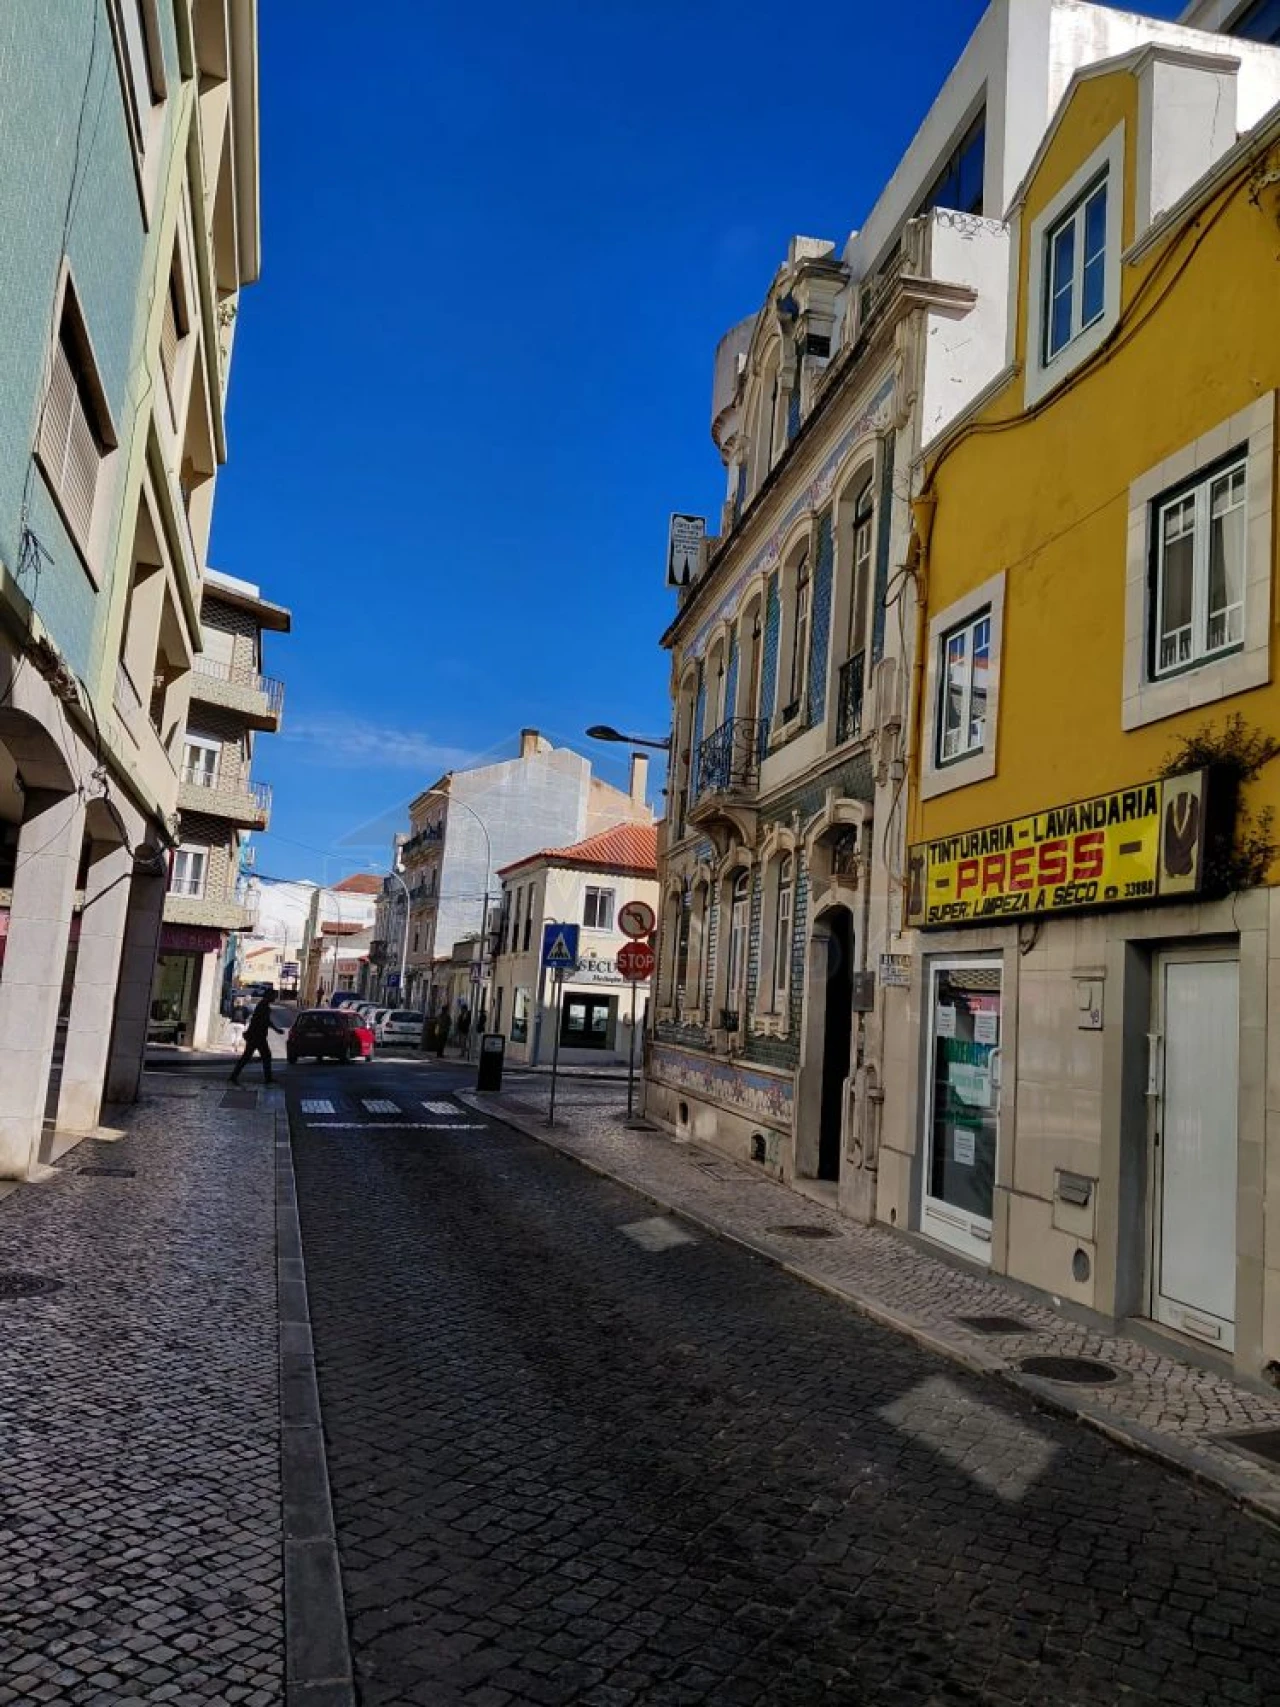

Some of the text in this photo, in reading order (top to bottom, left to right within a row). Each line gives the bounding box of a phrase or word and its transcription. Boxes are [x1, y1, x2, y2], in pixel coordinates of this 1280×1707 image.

[929, 822, 1015, 865] TINTURARIA
[1033, 785, 1157, 842] LAVANDARIA
[956, 831, 1105, 899] PRESS
[1035, 888, 1047, 910] A
[618, 953, 654, 969] STOP
